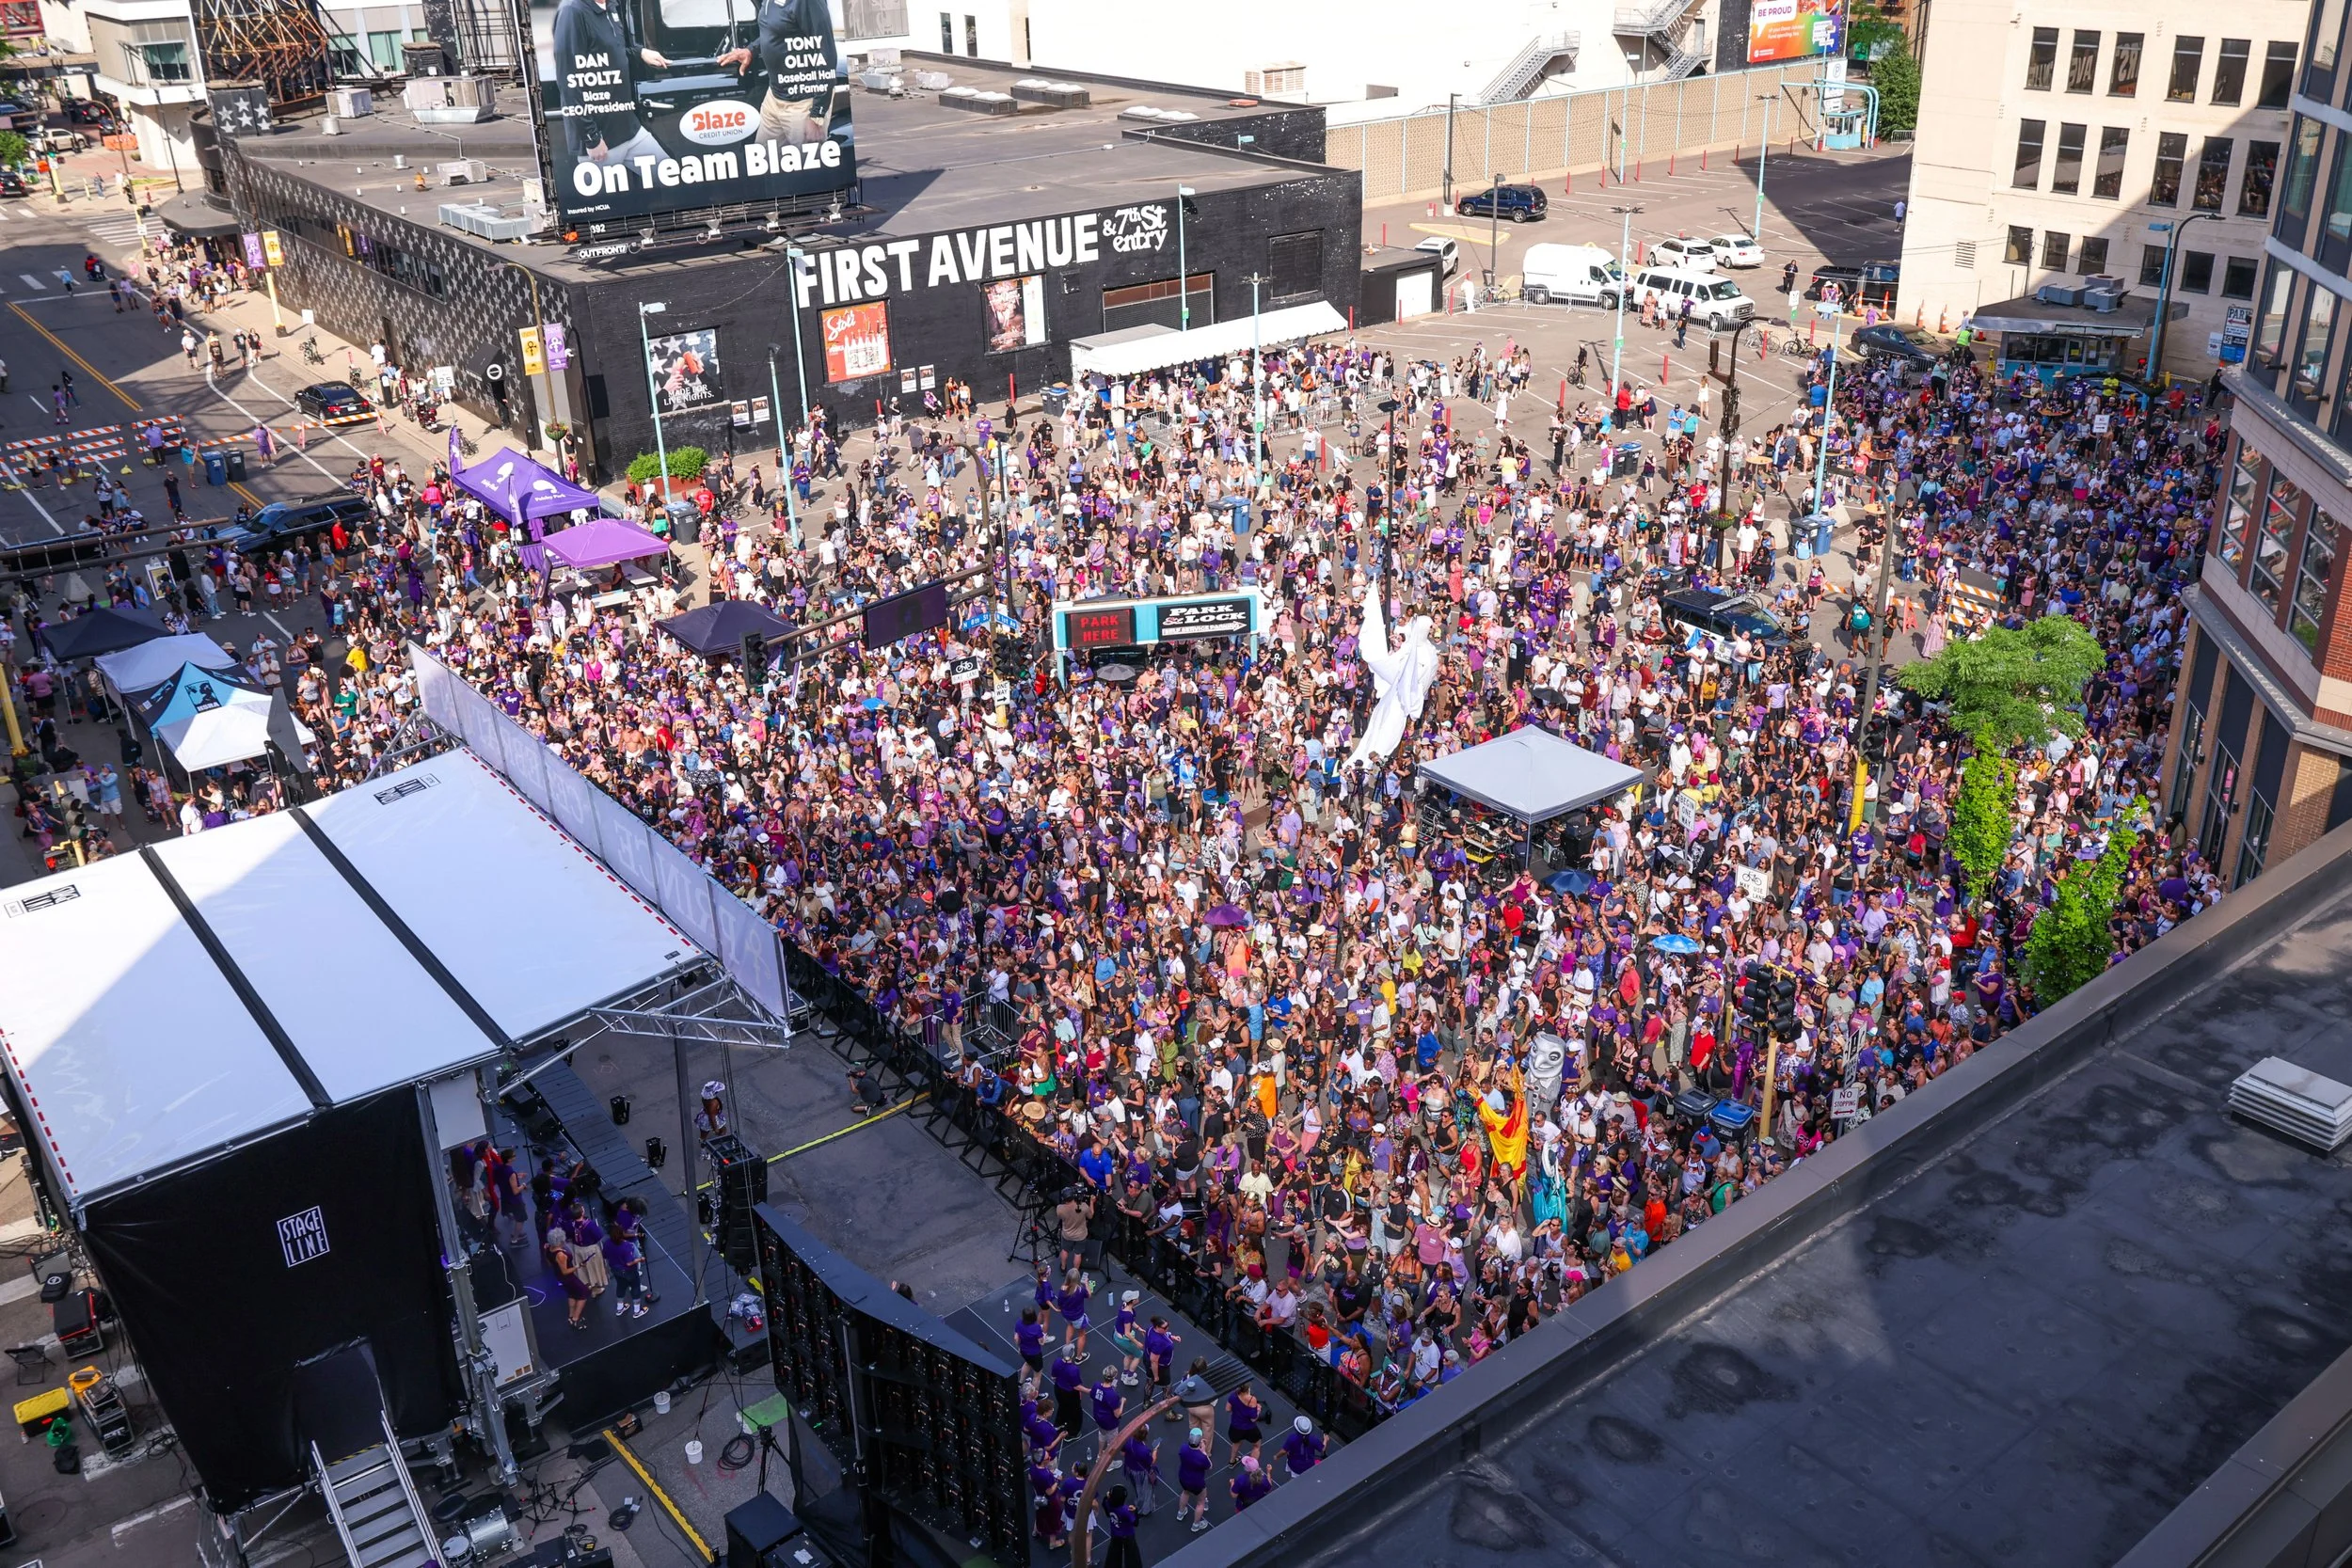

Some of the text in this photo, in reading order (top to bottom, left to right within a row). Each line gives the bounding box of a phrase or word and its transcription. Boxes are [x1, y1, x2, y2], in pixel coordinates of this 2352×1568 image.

[1758, 7, 1792, 17] BE PROUD
[785, 36, 823, 51] TONY
[575, 53, 609, 70] DAN
[785, 53, 827, 69] OLIVA
[566, 71, 622, 88] STOLTZ
[778, 70, 835, 84] Baseball Hall
[582, 89, 611, 103] Blaze
[787, 83, 828, 95] of Famer
[562, 101, 635, 118] CEO/President
[692, 111, 745, 132] Blaze
[573, 139, 841, 197] On Team Blaze
[567, 207, 587, 215] Insured
[591, 224, 606, 233] 392
[1113, 227, 1168, 252] entry
[795, 205, 1168, 309] FIRST AVENUE & 7th St
[668, 384, 707, 398] MADE FOR
[663, 395, 682, 406] LIVE
[1169, 605, 1233, 616] PARK
[1081, 616, 1119, 627] PARK
[1184, 612, 1246, 624] LOCK
[1084, 630, 1118, 641] HERE
[953, 669, 979, 682] BIKE LANE
[1680, 796, 1694, 810] BEGIN
[1682, 806, 1692, 816] ONE
[1681, 816, 1692, 827] WAY
[282, 1210, 321, 1241] STAGE
[287, 1231, 326, 1264] LINE
